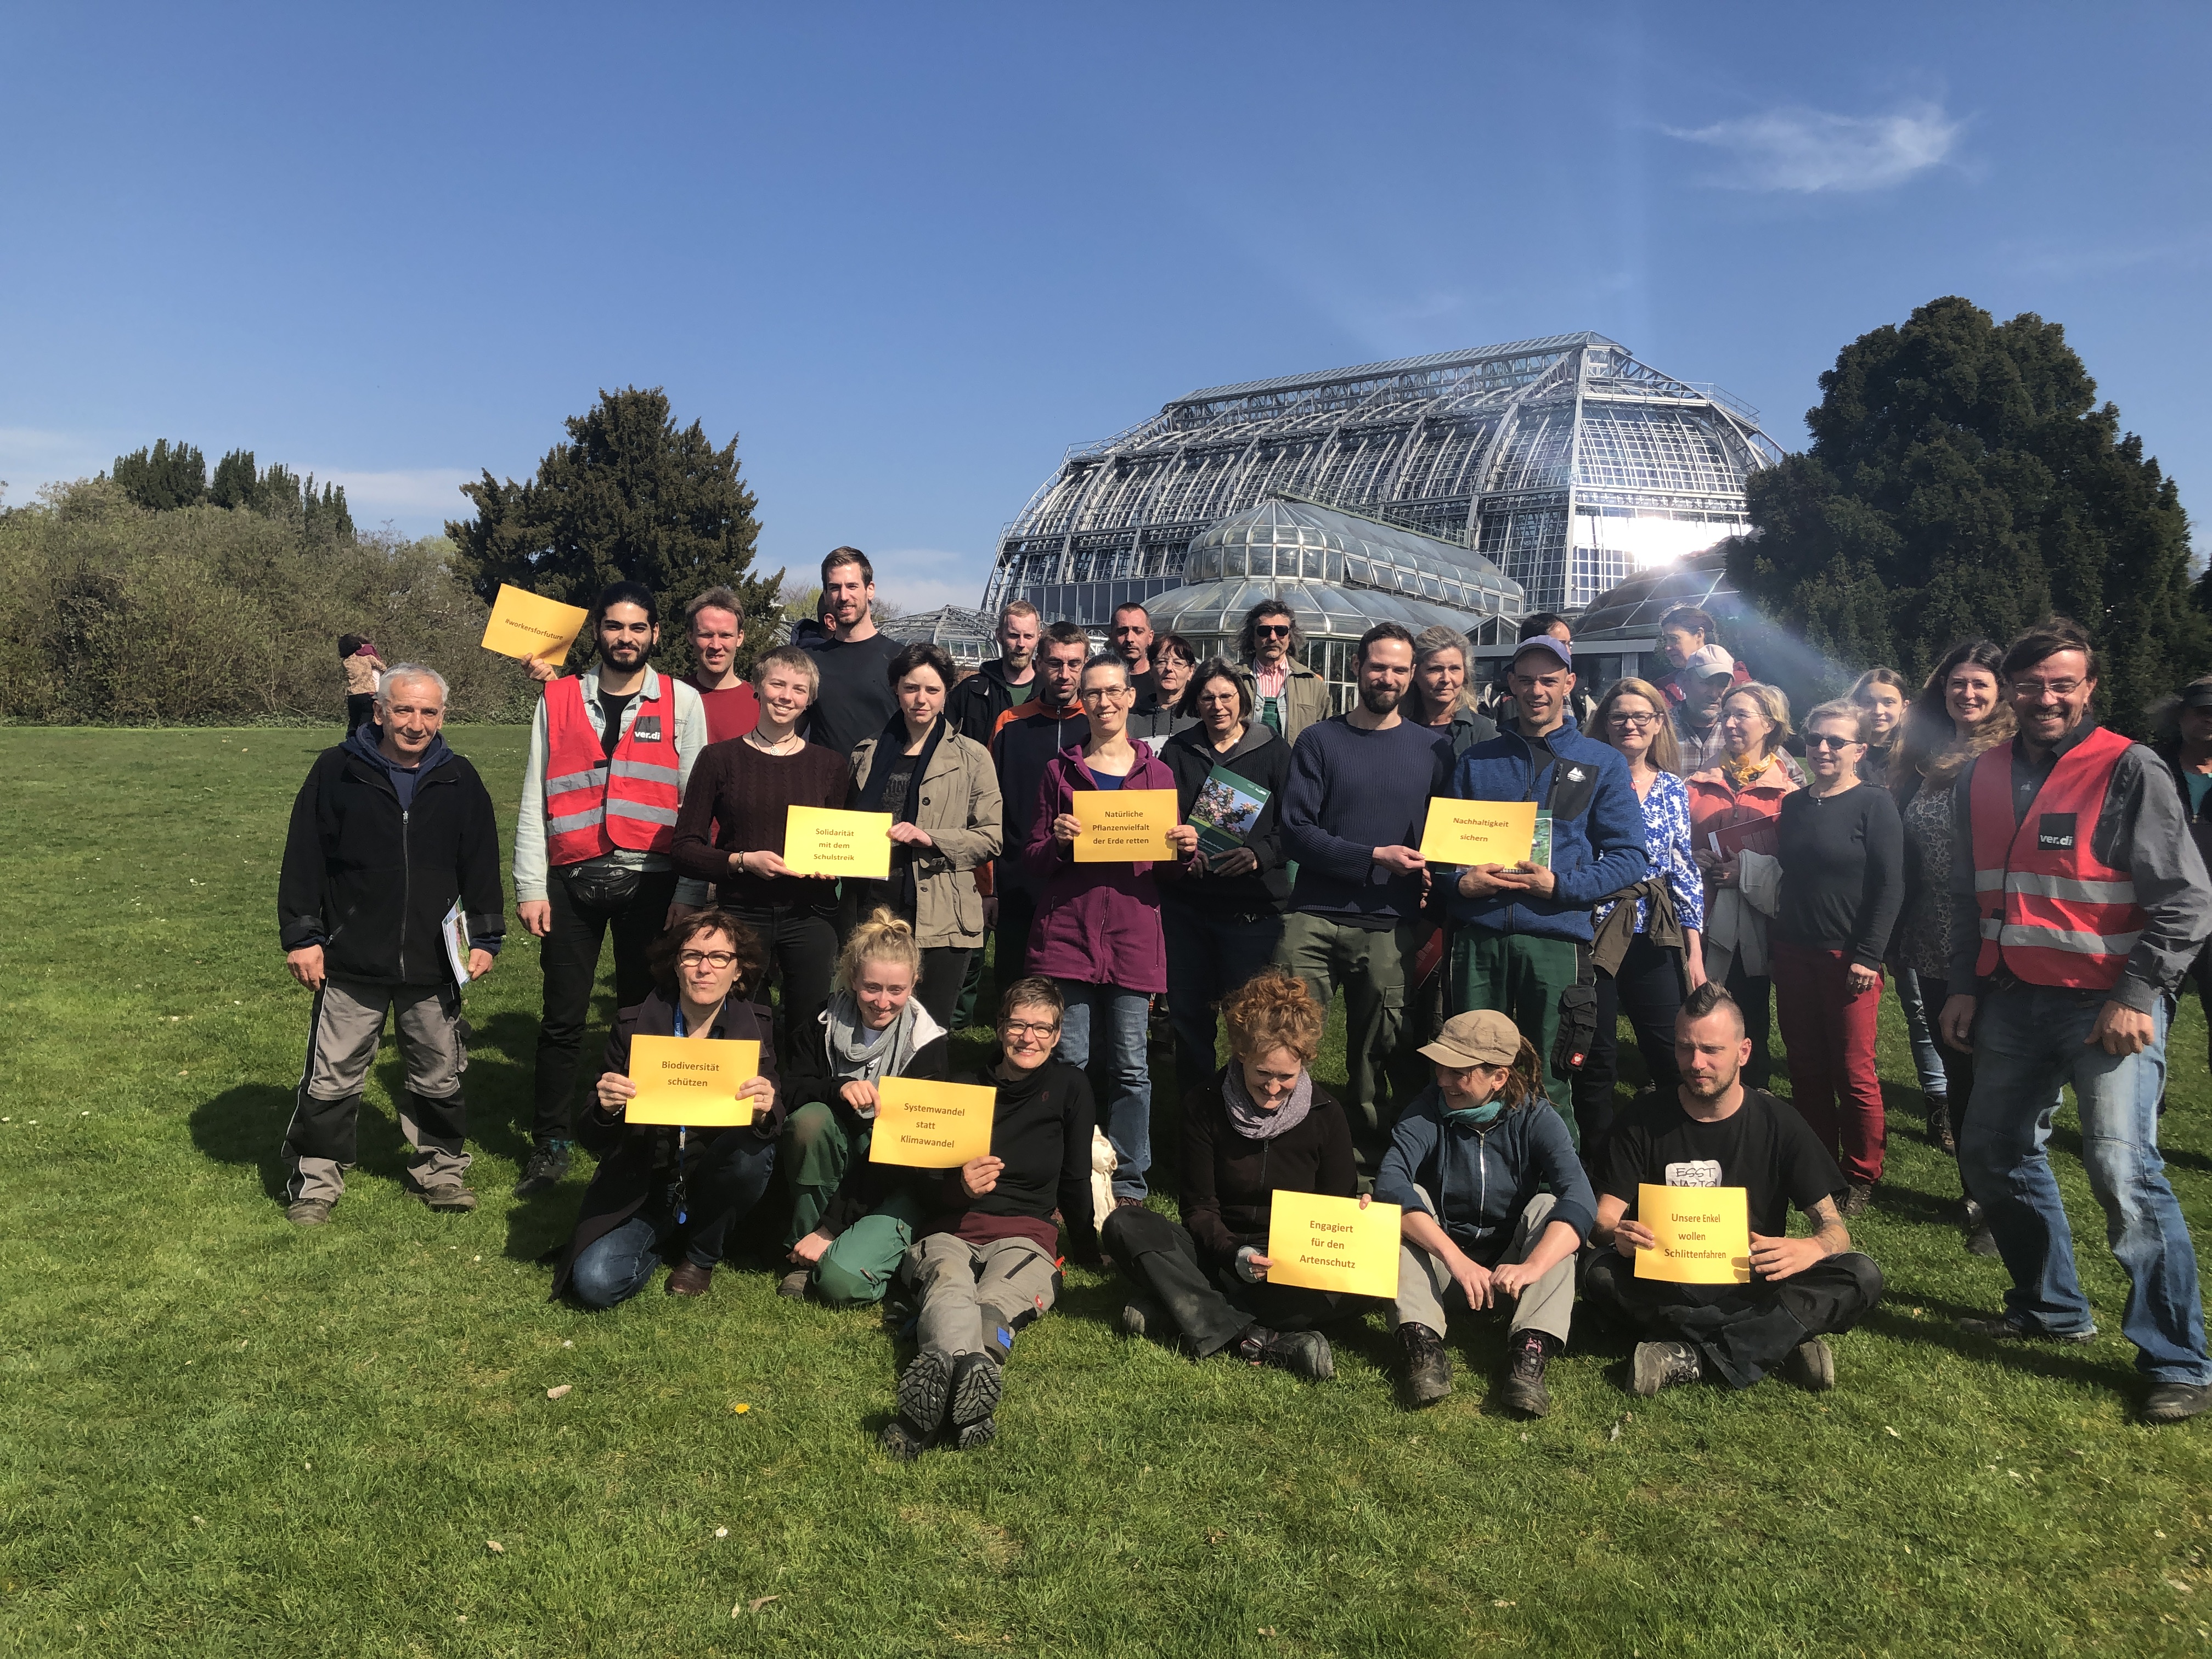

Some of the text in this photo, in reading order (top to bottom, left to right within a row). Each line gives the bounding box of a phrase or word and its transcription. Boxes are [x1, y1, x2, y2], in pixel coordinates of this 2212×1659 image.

[505, 618, 563, 640] #workersforfuture
[634, 731, 661, 740] ver.di
[1453, 817, 1509, 828] Nachhaltigkeit
[815, 828, 855, 837] Solidarität
[1459, 834, 1488, 842] sichern
[2040, 834, 2073, 845] ver.di
[662, 1060, 720, 1072] Biodiversität
[667, 1077, 708, 1087] schützen
[904, 1103, 966, 1116] Systemwandel
[916, 1121, 936, 1130] statt
[900, 1135, 955, 1148] Klimawandel
[1676, 1167, 1716, 1177] ESST
[1671, 1213, 1721, 1223] Unsere Enkel
[1310, 1220, 1354, 1233] Engagiert
[1678, 1231, 1706, 1241] wollen
[1311, 1237, 1345, 1250] für den
[1664, 1249, 1726, 1259] Schlittenfahren
[1299, 1254, 1356, 1269] Artenschutz
